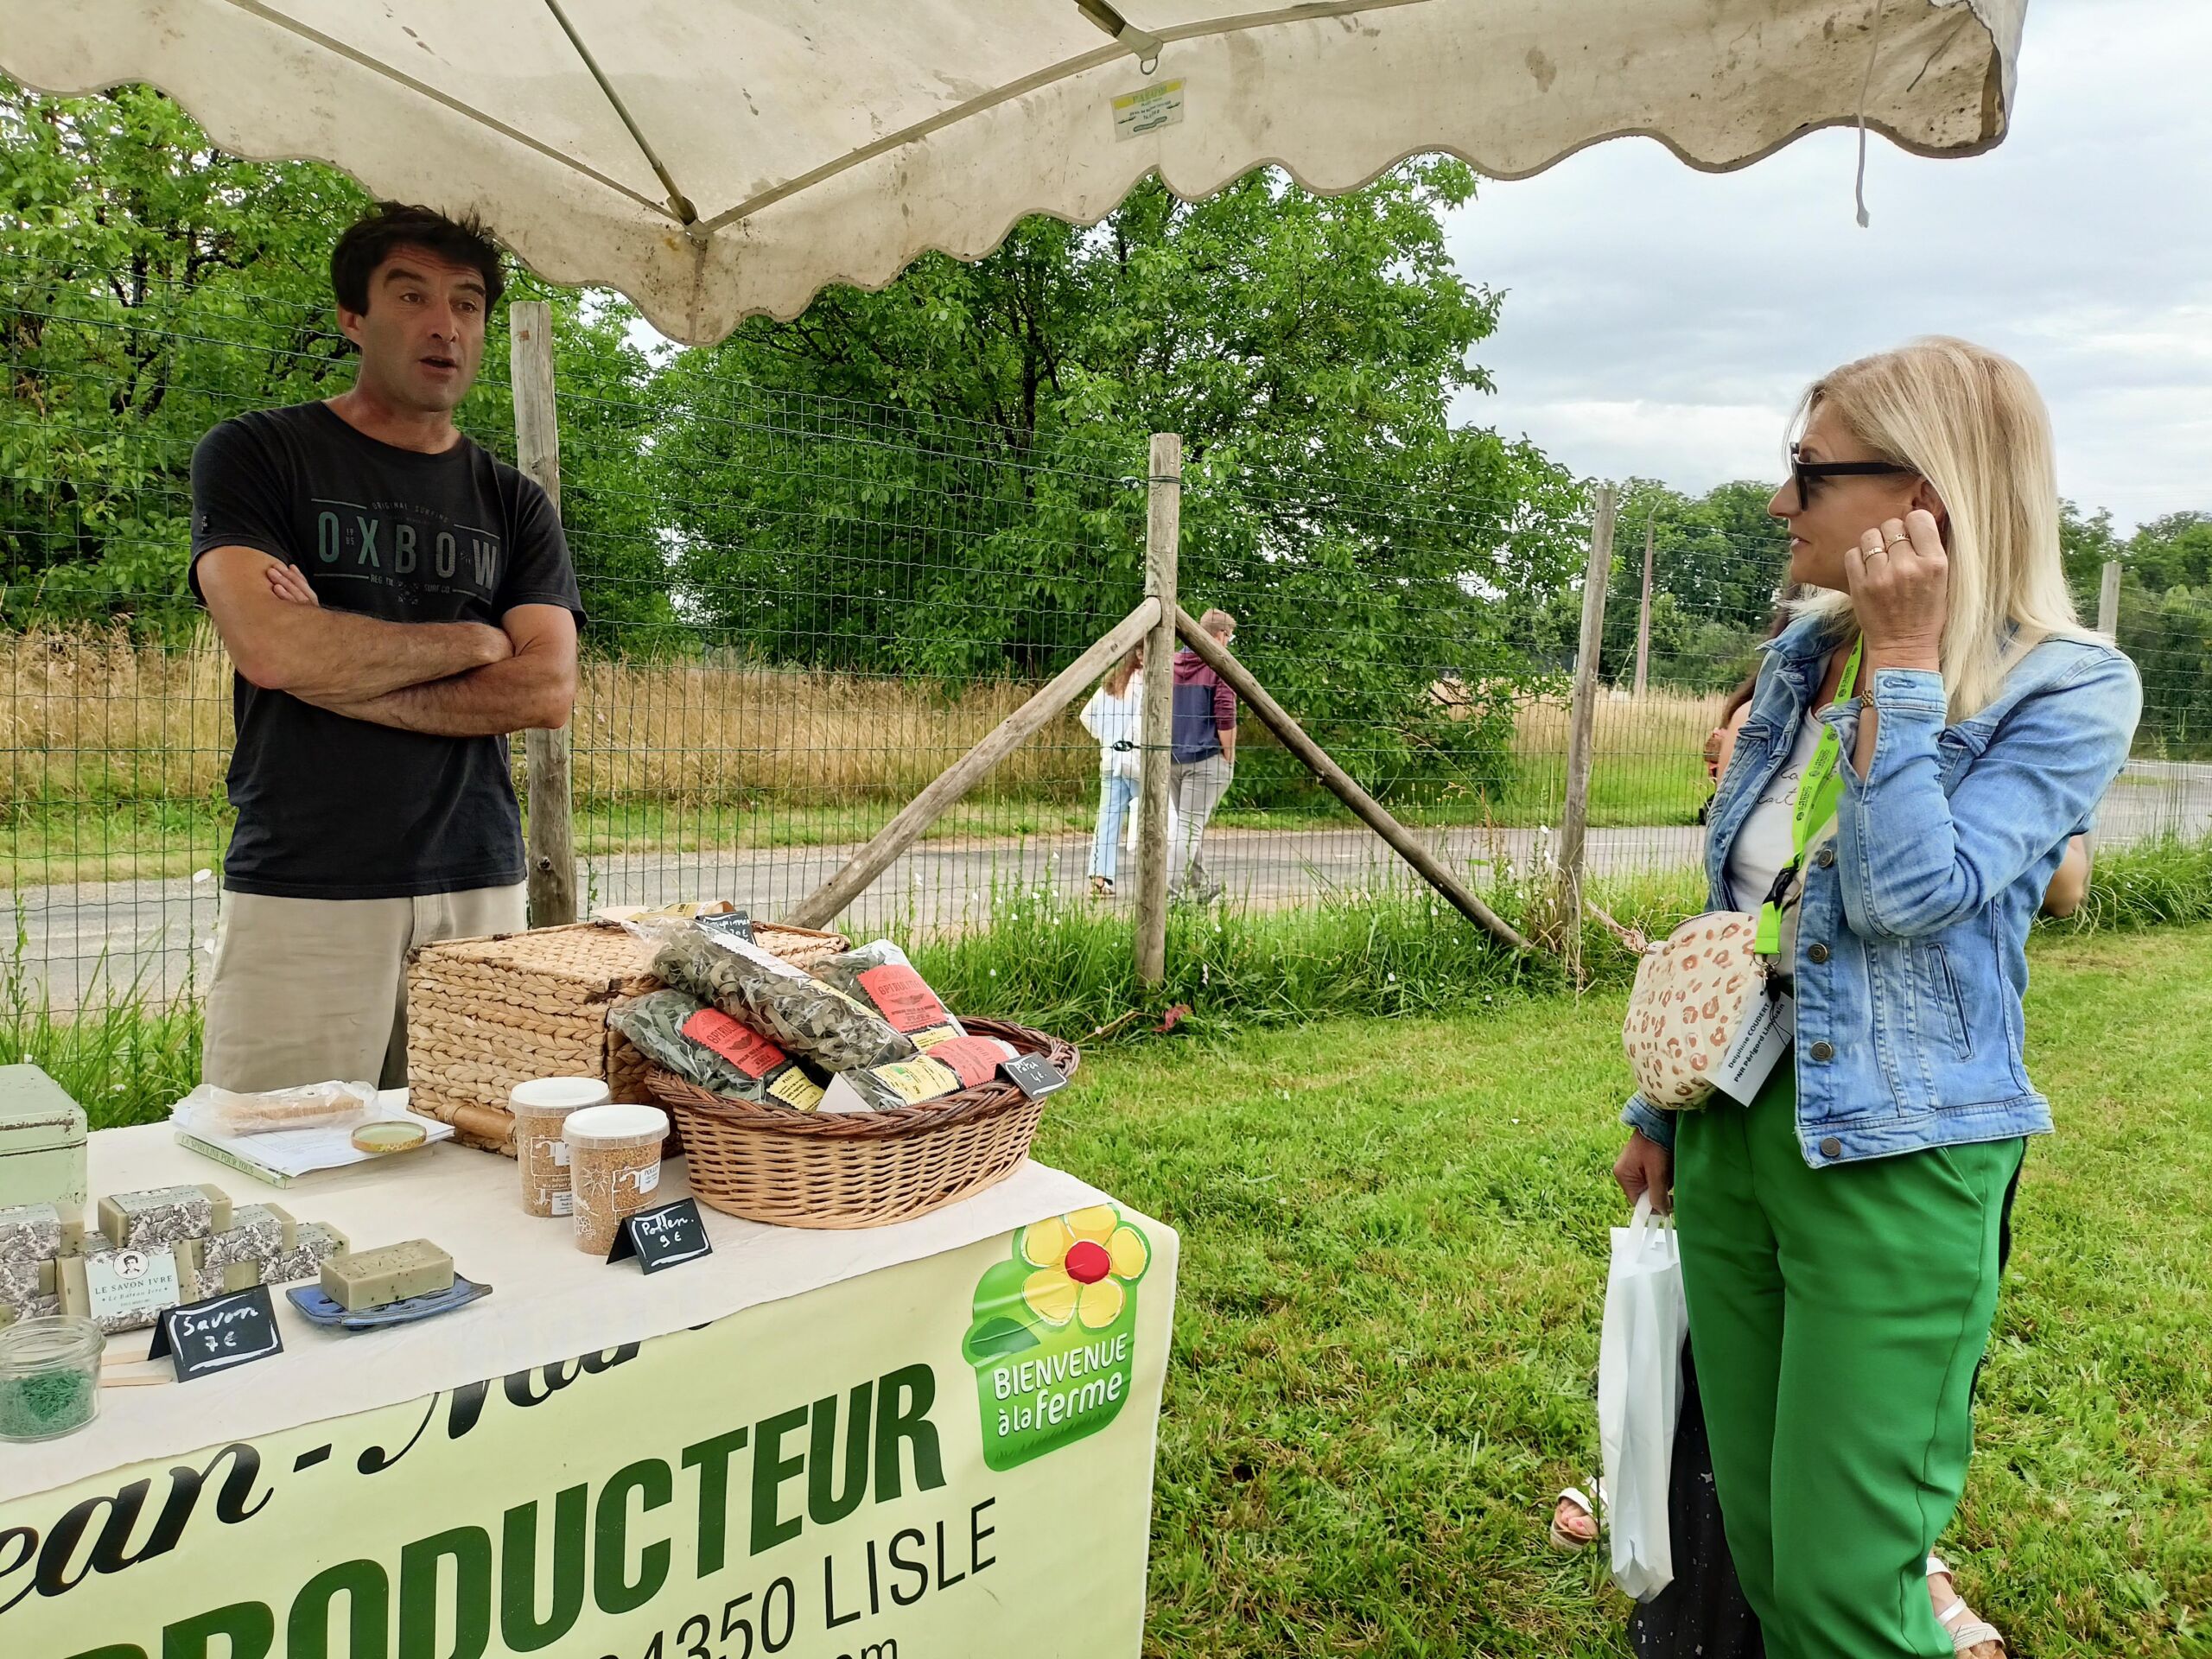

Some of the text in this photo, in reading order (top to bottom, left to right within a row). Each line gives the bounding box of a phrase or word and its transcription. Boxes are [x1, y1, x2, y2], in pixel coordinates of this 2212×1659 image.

[318, 511, 499, 591] OXBOW
[1728, 1002, 1770, 1069] Delphine COUDERT
[1733, 1067, 1746, 1083] PNR
[181, 1135, 255, 1174] LA SPIRULINE POUR TOUS
[659, 1235, 671, 1248] 9
[95, 1274, 173, 1294] LE SAVON IVRE
[183, 1306, 259, 1337] Savon
[204, 1331, 237, 1352] 7 €
[993, 1332, 1128, 1401] BIENVENUE
[1035, 1371, 1122, 1430] ferme
[824, 1497, 996, 1630] LISLE
